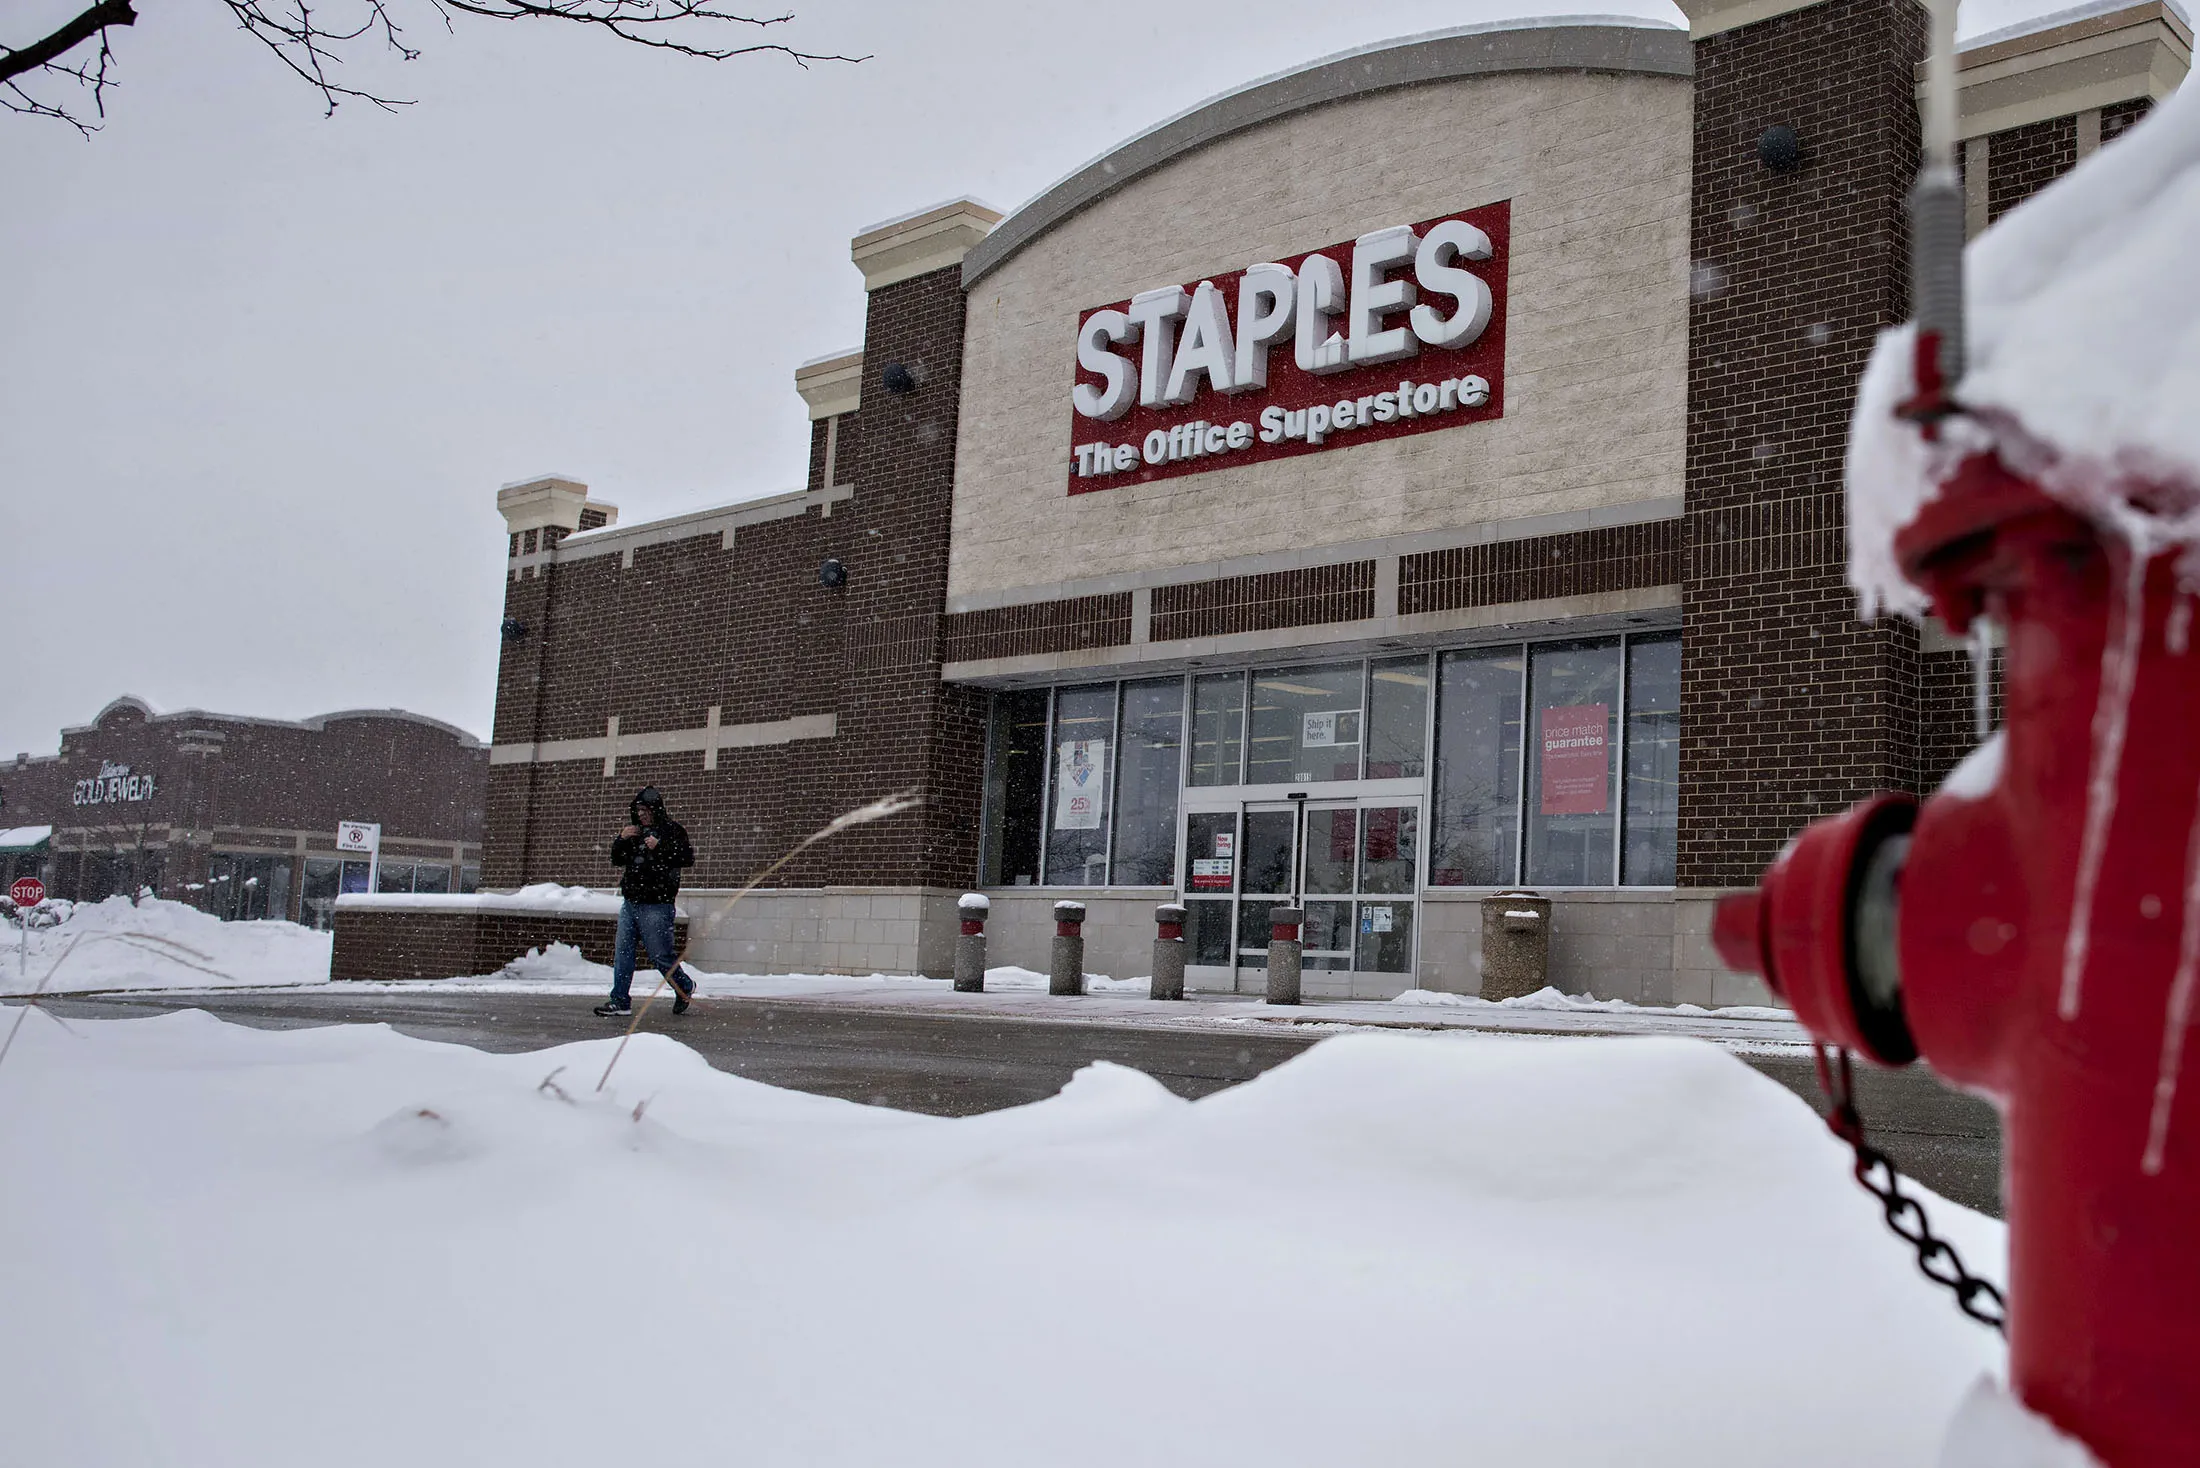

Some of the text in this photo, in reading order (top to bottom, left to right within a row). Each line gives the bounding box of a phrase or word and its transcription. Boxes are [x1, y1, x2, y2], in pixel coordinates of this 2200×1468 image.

[1072, 220, 1493, 422] STAPLES
[1074, 375, 1490, 478] The Office Superstore
[1307, 718, 1332, 731] Ship it
[1545, 724, 1603, 741] price match
[1545, 737, 1603, 752] guarantee
[73, 774, 156, 805] GOLD JEWELRY
[13, 886, 44, 899] STOP
